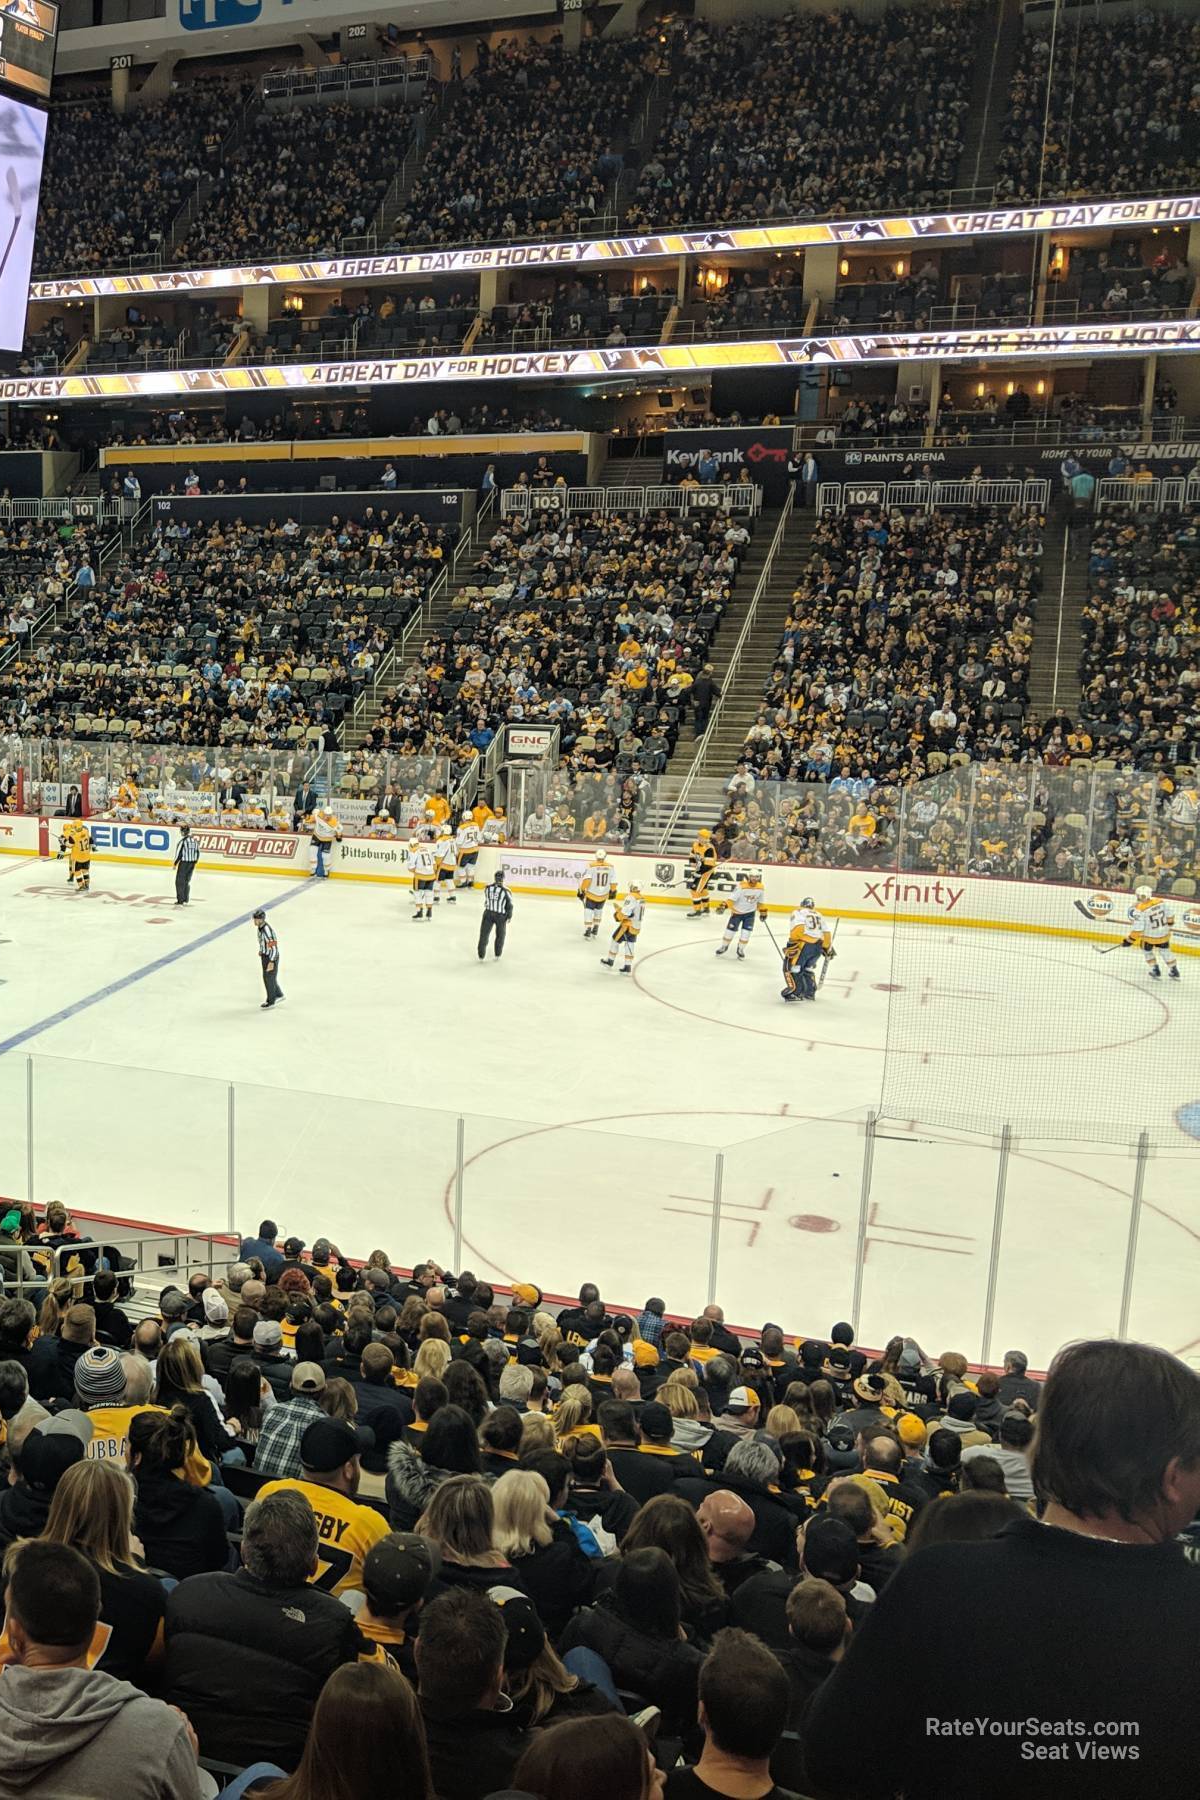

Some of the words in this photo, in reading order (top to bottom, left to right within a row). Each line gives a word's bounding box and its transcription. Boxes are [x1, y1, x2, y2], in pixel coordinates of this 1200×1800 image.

[347, 26, 367, 37] 202
[111, 56, 132, 69] 201
[952, 211, 1044, 232] GREAT
[1052, 206, 1104, 227] DAY
[1108, 203, 1147, 219] FOR
[1153, 199, 1200, 219] HO
[327, 263, 339, 275] A
[342, 256, 412, 276] GREAT
[418, 252, 459, 270] DAY
[462, 251, 492, 265] FOR
[495, 243, 592, 265] HOCKEY
[311, 368, 322, 380] A
[326, 364, 398, 382] GREAT
[403, 361, 444, 379] DAY
[448, 360, 477, 374] FOR
[481, 354, 578, 375] HOCKEY
[864, 452, 904, 463] PAINTS
[905, 451, 946, 462] ARENA
[1086, 448, 1113, 459] YOUR
[442, 495, 458, 504] 102
[533, 495, 560, 510] 103
[691, 493, 720, 507] 103
[848, 489, 879, 505] 104
[75, 504, 94, 517] 101
[157, 501, 171, 511] 102
[511, 735, 549, 745] GNC
[91, 825, 170, 851] EICO
[228, 840, 254, 856] NEL
[256, 837, 295, 855] LOCK
[341, 846, 397, 863] Pittsburgh
[420, 853, 432, 867] 13
[596, 872, 609, 888] 10
[863, 877, 965, 911] xfinity
[1087, 899, 1113, 910] Gulf
[1149, 910, 1169, 930] 52
[87, 1437, 128, 1460] UBBA
